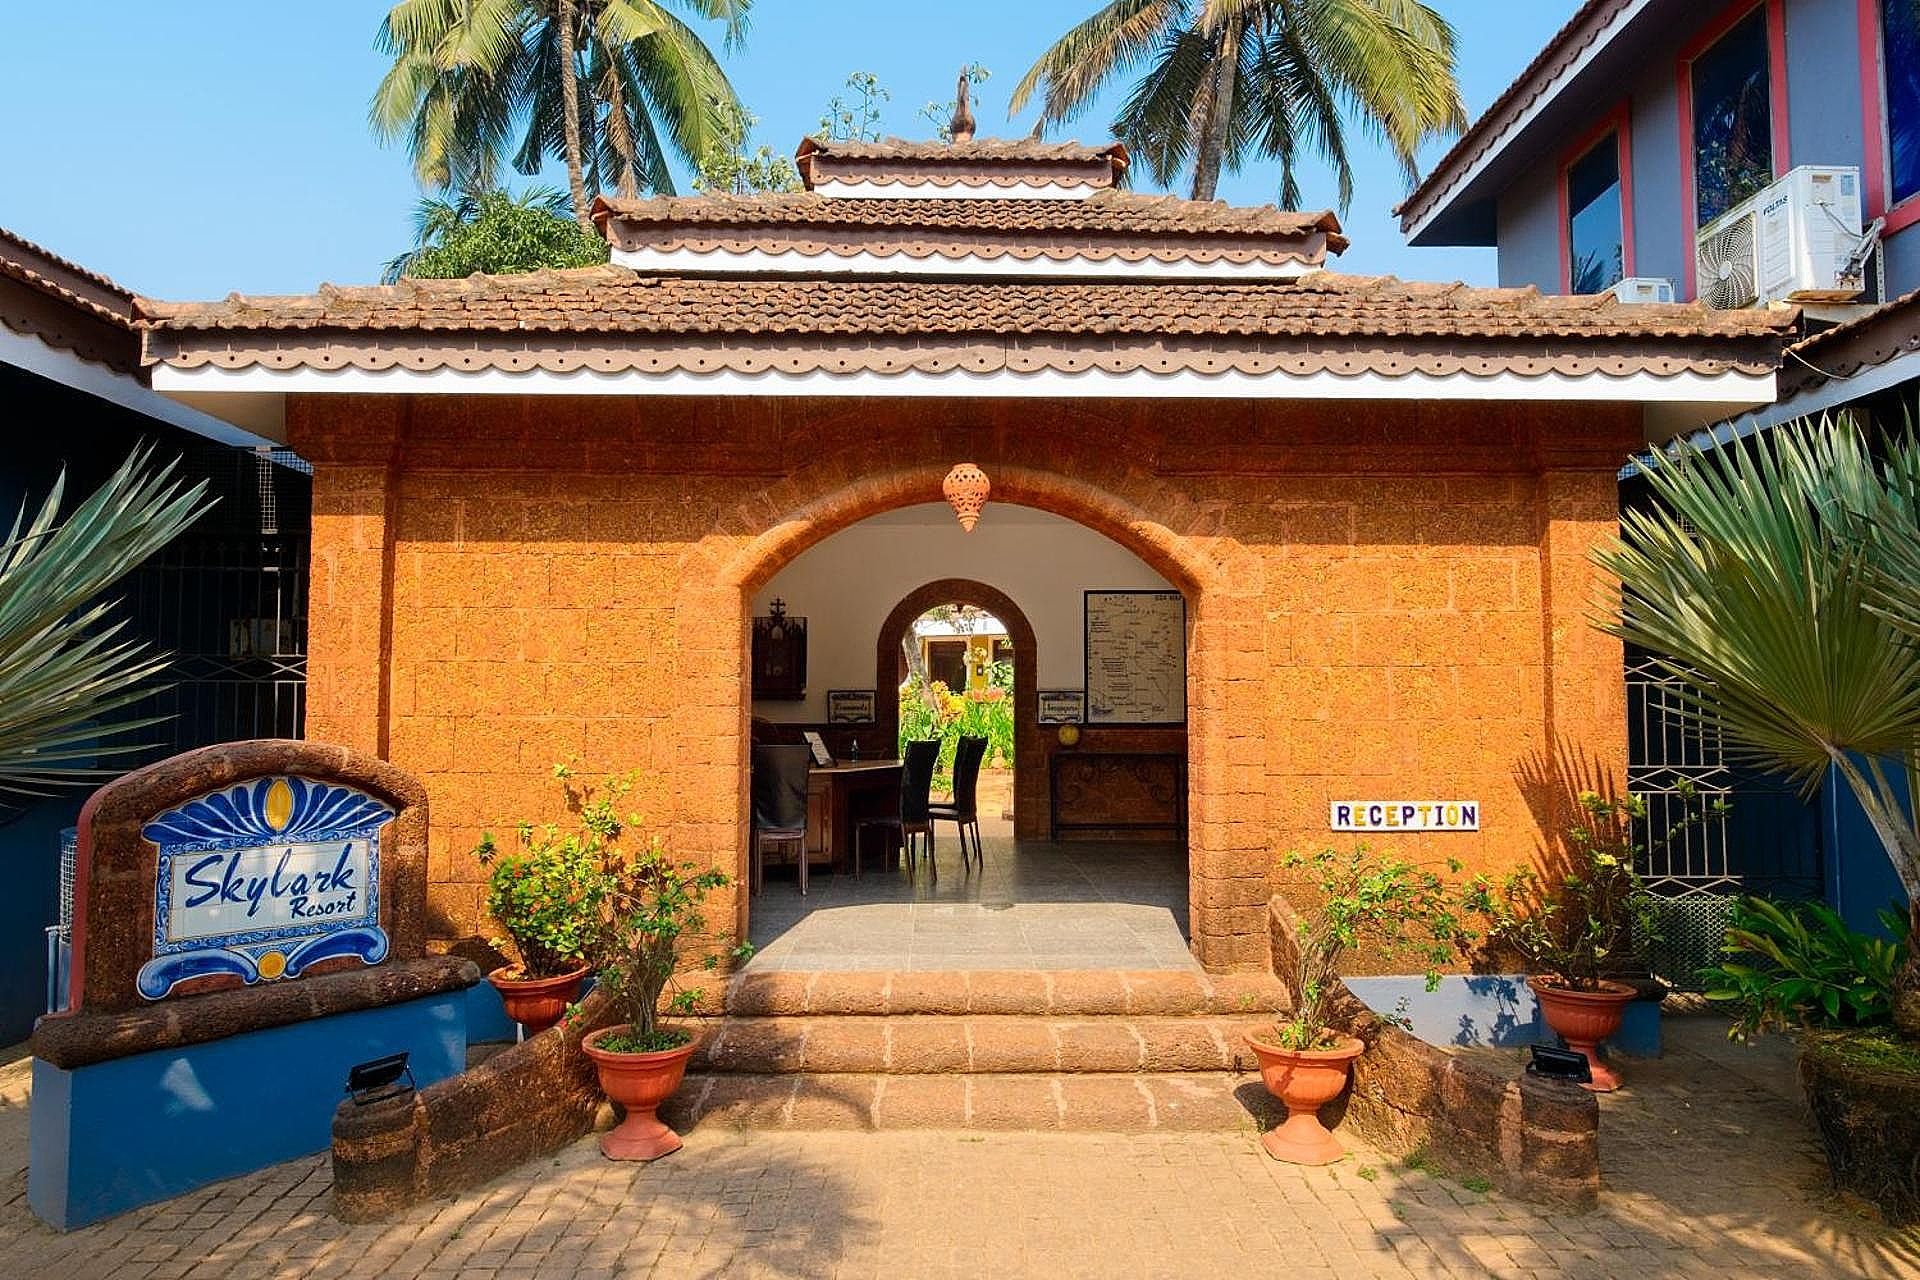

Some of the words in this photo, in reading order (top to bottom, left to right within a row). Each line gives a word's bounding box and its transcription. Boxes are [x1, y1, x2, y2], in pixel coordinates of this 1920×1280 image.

[1337, 805, 1476, 826] RECEPTION
[185, 843, 356, 917] Skylark
[291, 891, 356, 919] Resort
